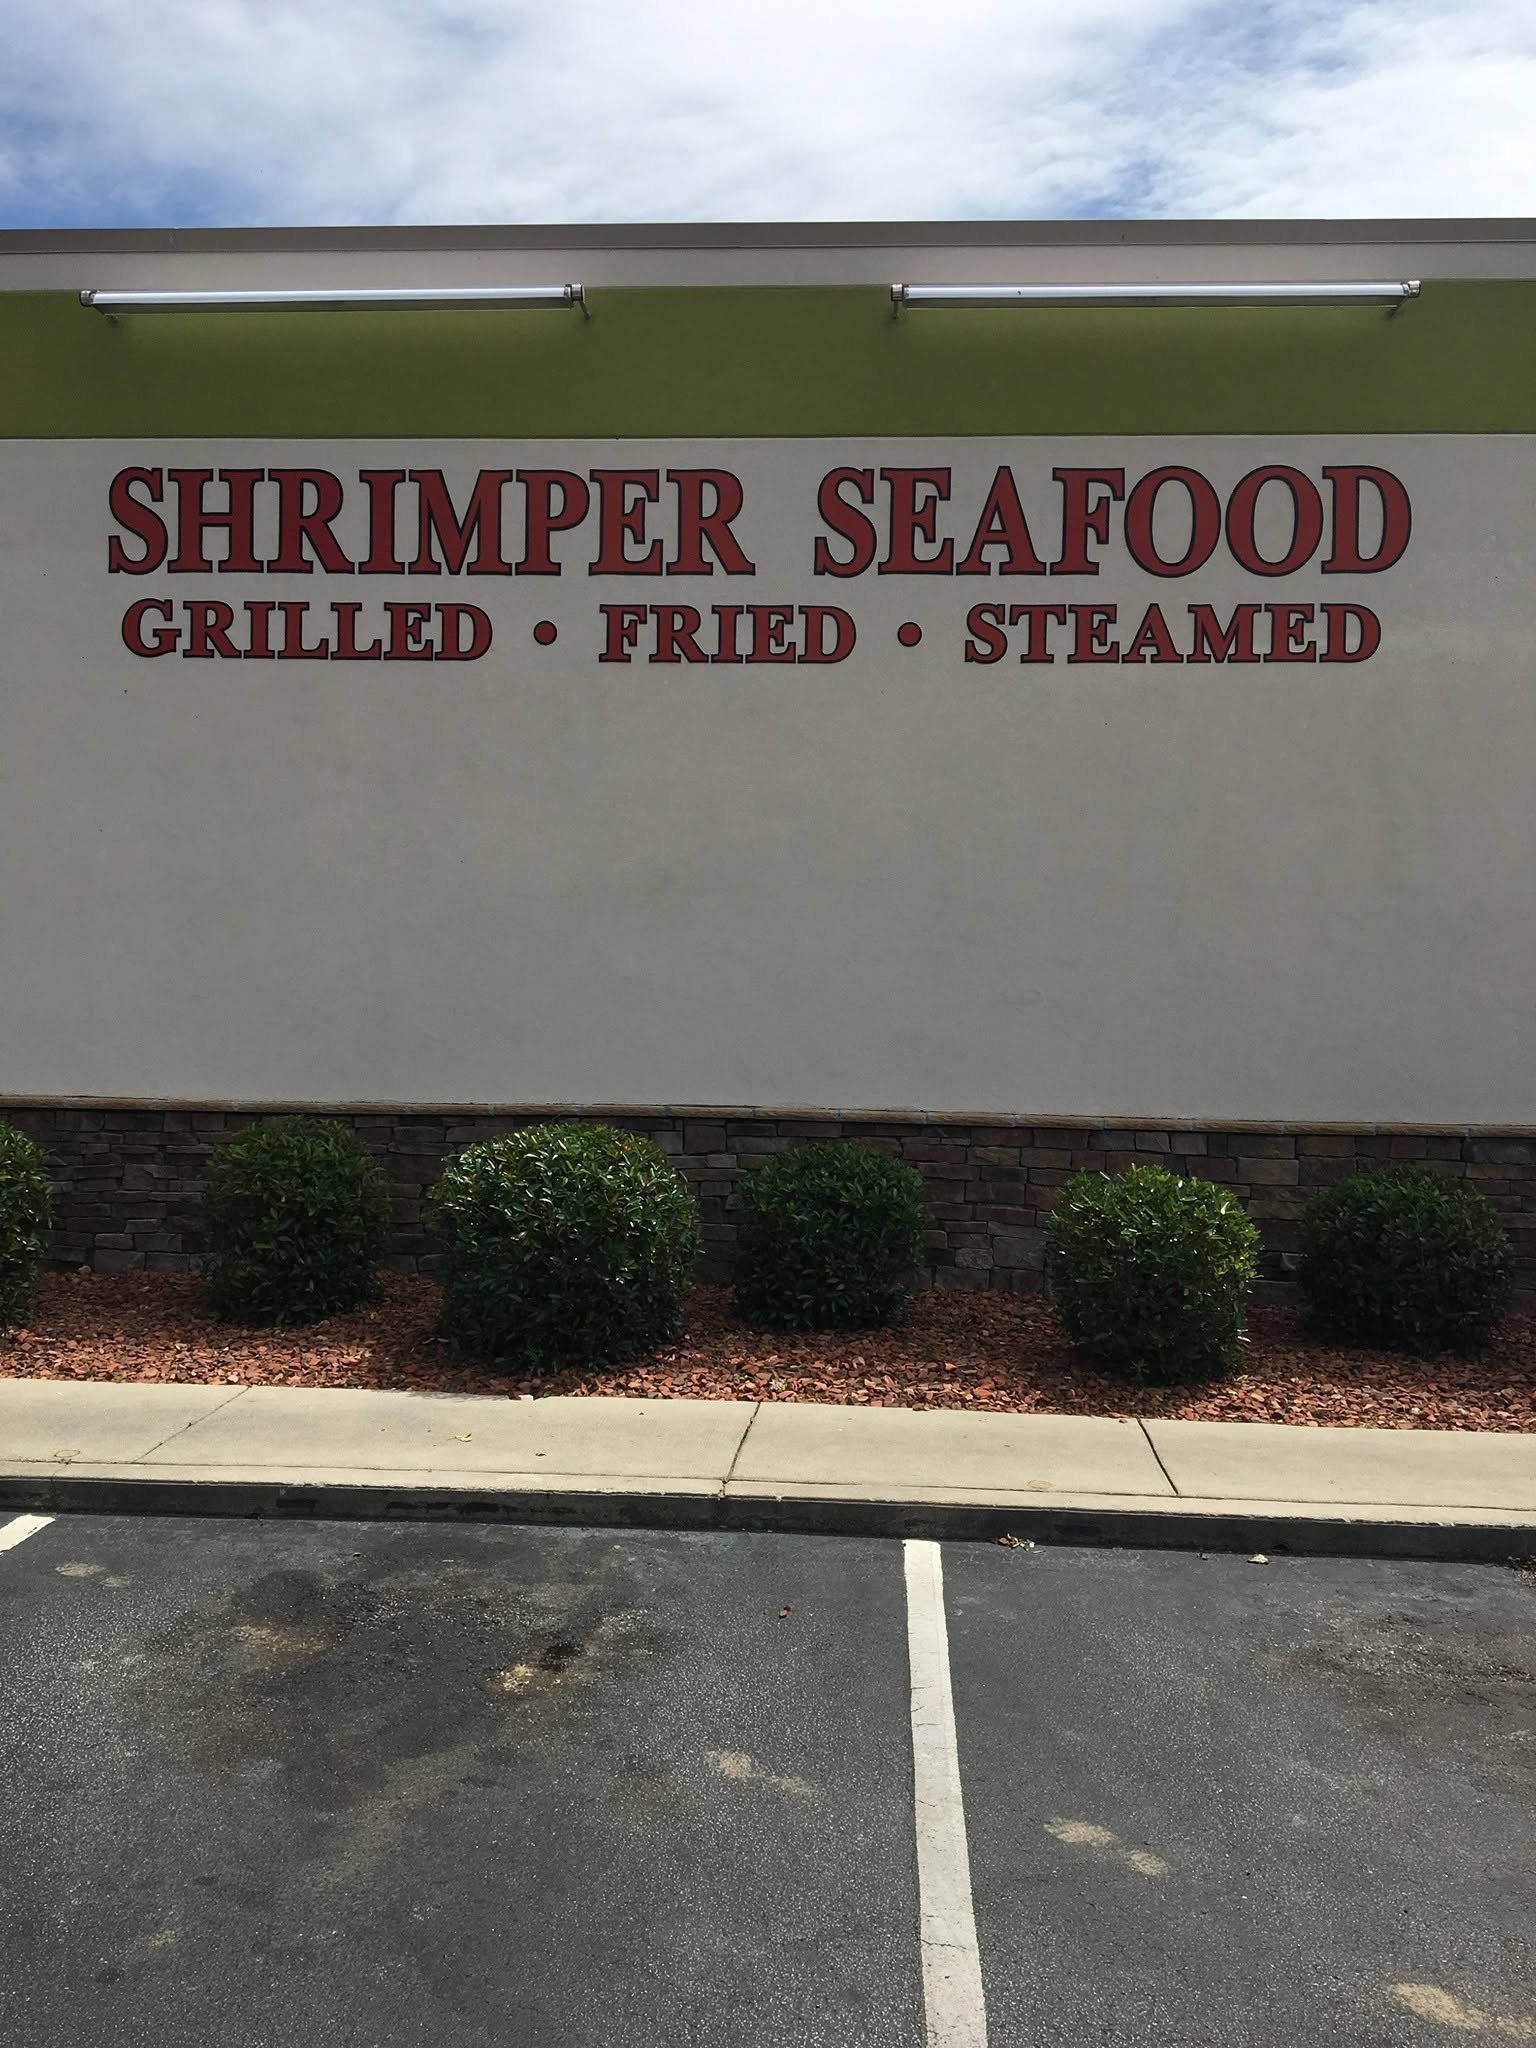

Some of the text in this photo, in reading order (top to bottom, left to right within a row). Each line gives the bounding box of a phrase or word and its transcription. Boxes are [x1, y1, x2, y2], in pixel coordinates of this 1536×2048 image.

[107, 464, 1413, 579] SHRIMPER SEAFOOD
[121, 597, 1382, 665] GRILLED FRIED STEAMED
